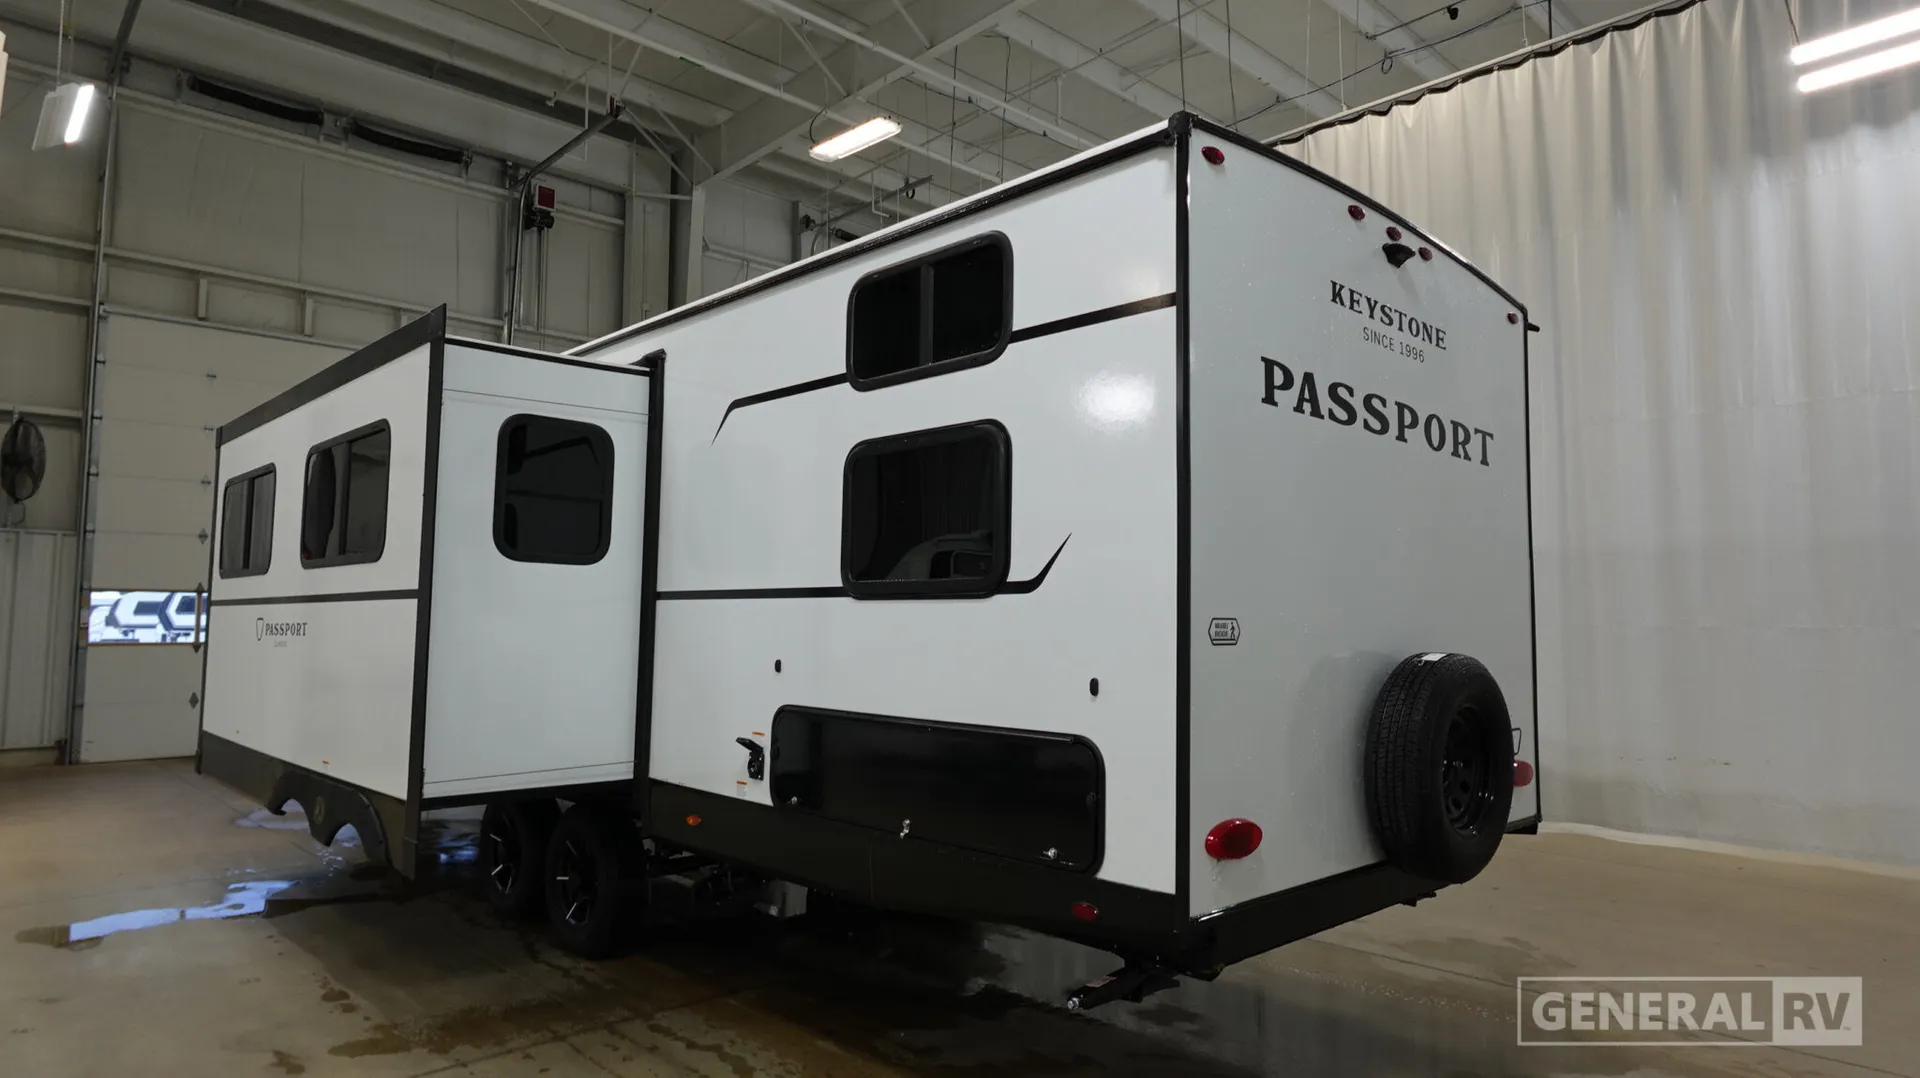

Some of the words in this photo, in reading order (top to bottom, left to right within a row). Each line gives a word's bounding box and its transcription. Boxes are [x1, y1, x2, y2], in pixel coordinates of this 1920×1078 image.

[1329, 279, 1447, 351] KEYSTONE
[1362, 326, 1395, 352] SINCE
[1399, 341, 1425, 364] 1996
[1260, 355, 1494, 467] PASSPORT
[265, 622, 307, 636] PASSPORT
